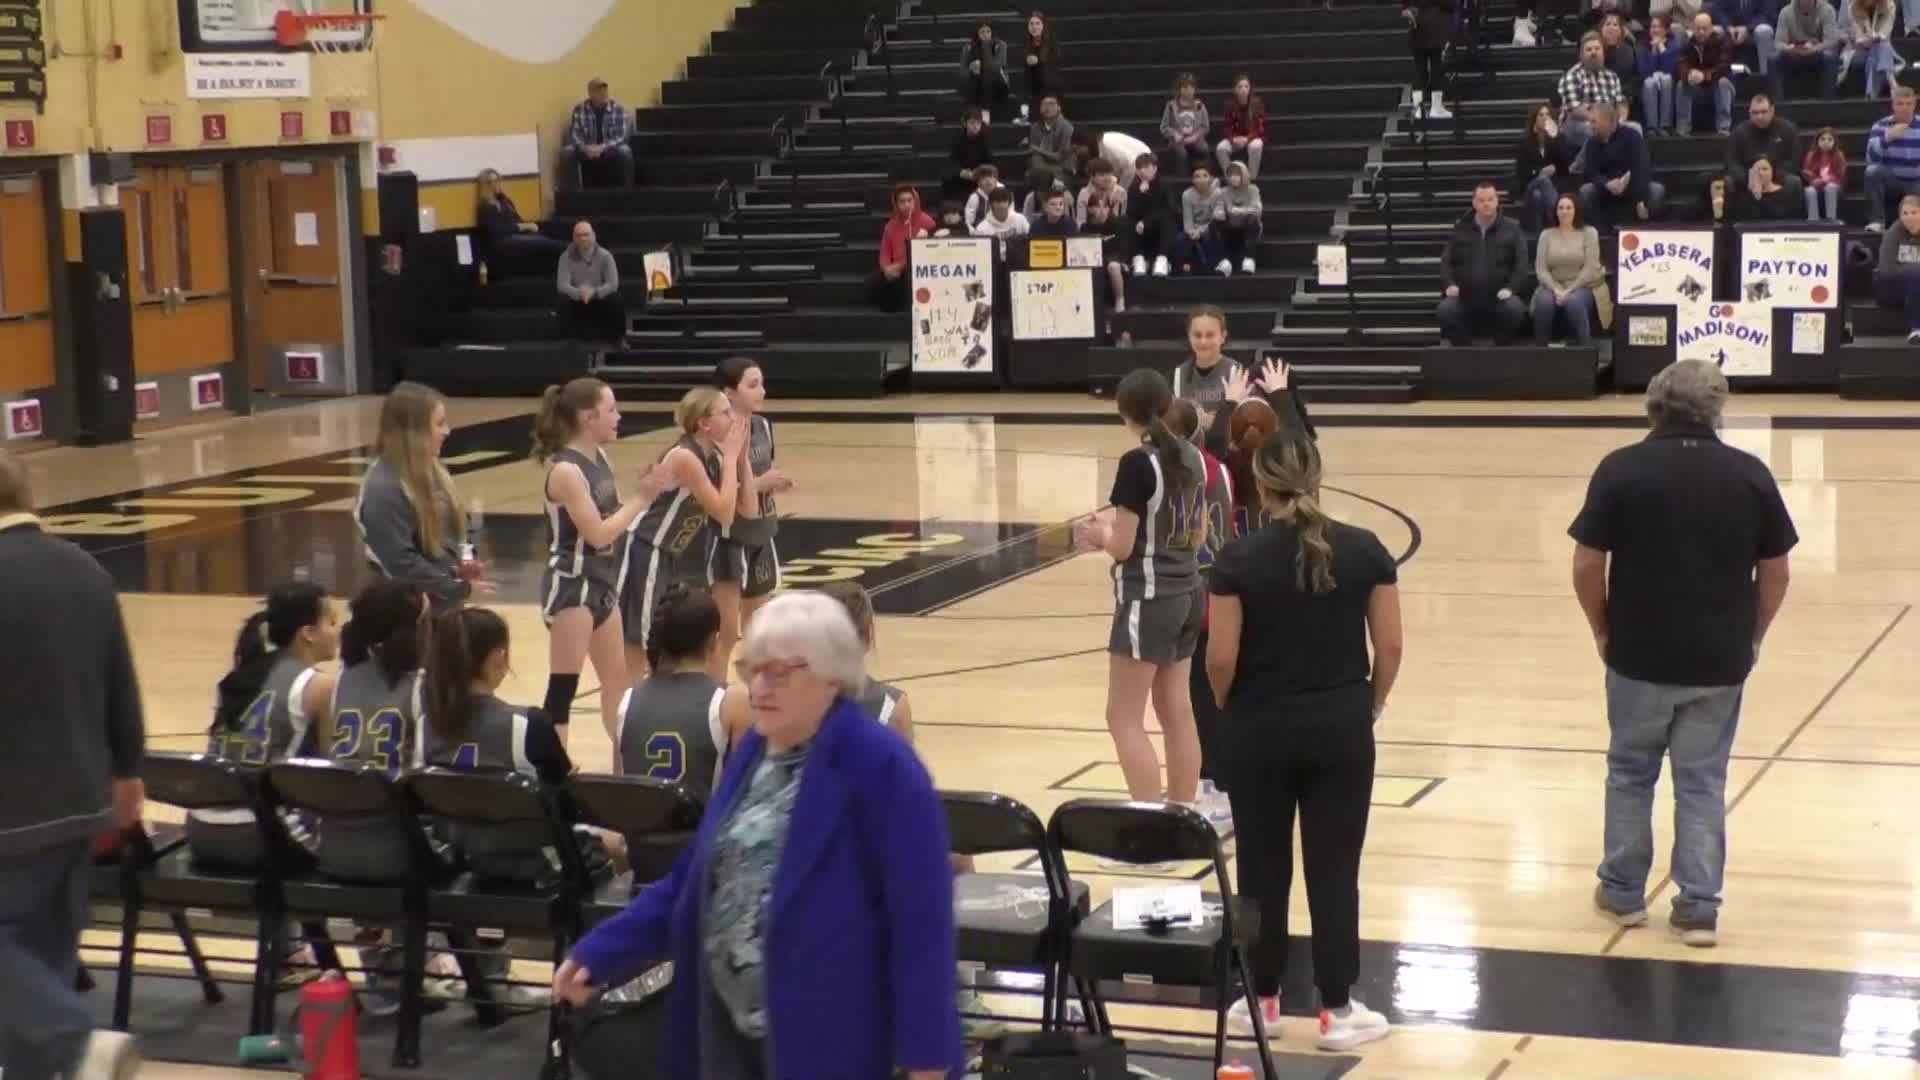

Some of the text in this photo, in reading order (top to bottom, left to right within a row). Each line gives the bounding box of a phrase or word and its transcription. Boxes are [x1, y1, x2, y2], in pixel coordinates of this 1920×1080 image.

[915, 264, 977, 278] MEGAN
[1620, 242, 1712, 272] YEABSERA
[1747, 259, 1828, 277] PAYTON
[1678, 319, 1769, 347] MADISON!
[330, 707, 406, 783] 23
[645, 730, 687, 784] 2
